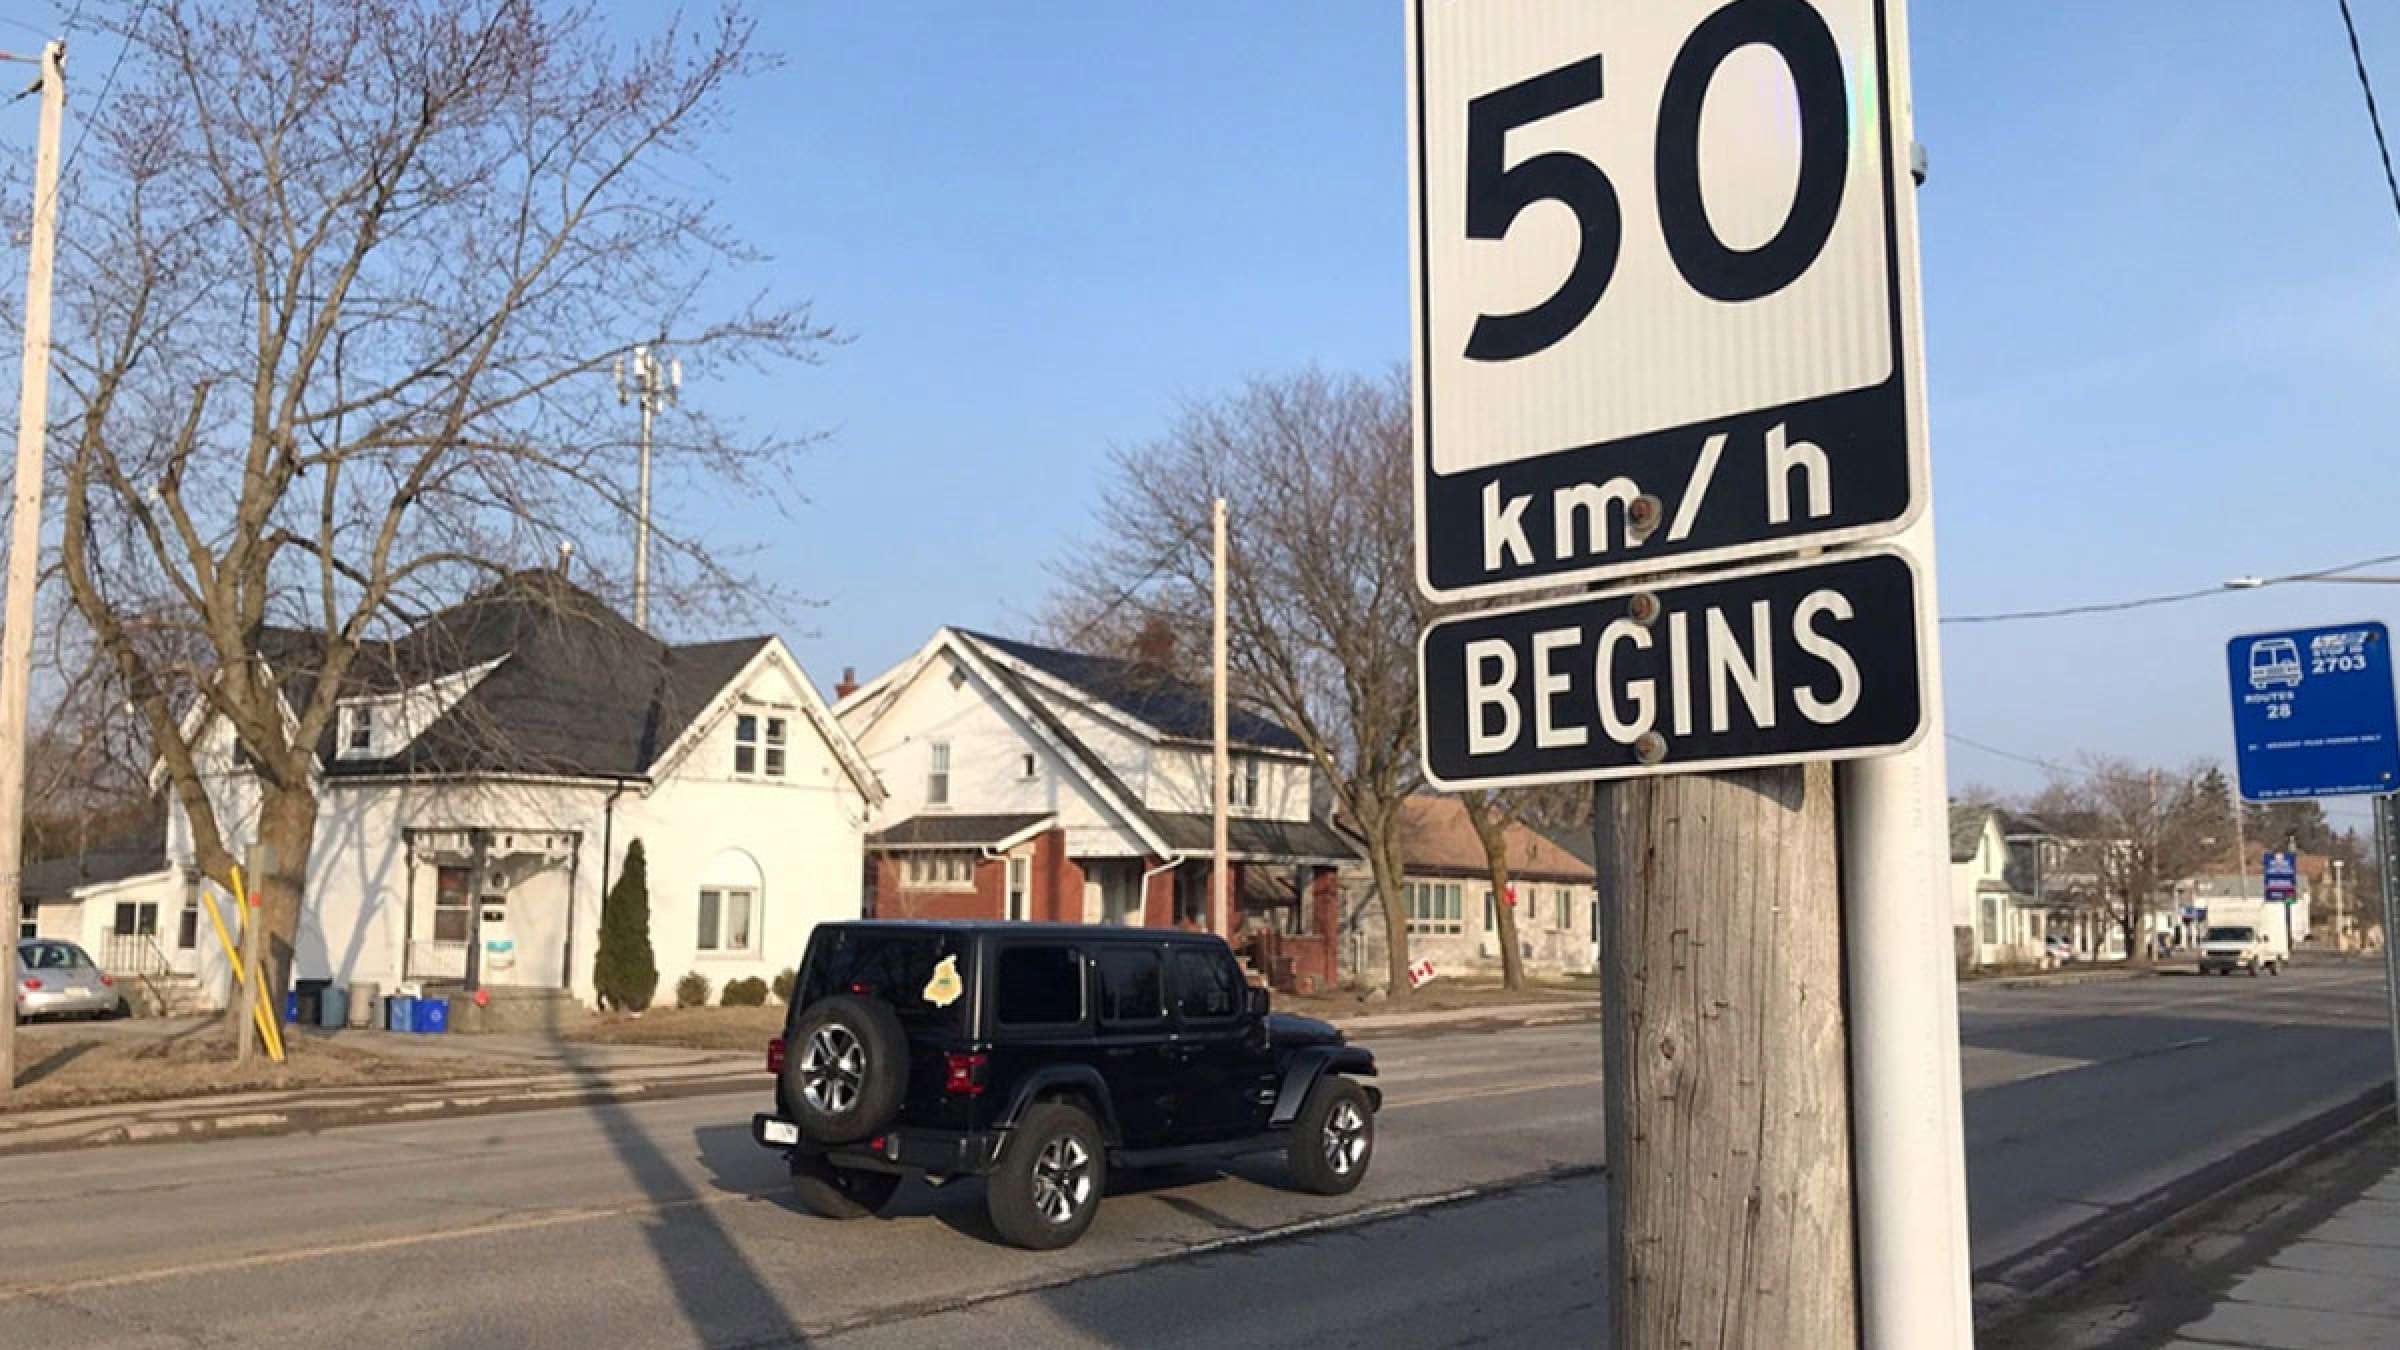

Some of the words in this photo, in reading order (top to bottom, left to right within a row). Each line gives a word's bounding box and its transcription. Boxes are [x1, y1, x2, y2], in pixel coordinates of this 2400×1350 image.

[1463, 0, 1850, 363] 50
[1483, 421, 1832, 571] km/h
[1466, 589, 1862, 755] BEGINS
[2311, 654, 2367, 675] 2703
